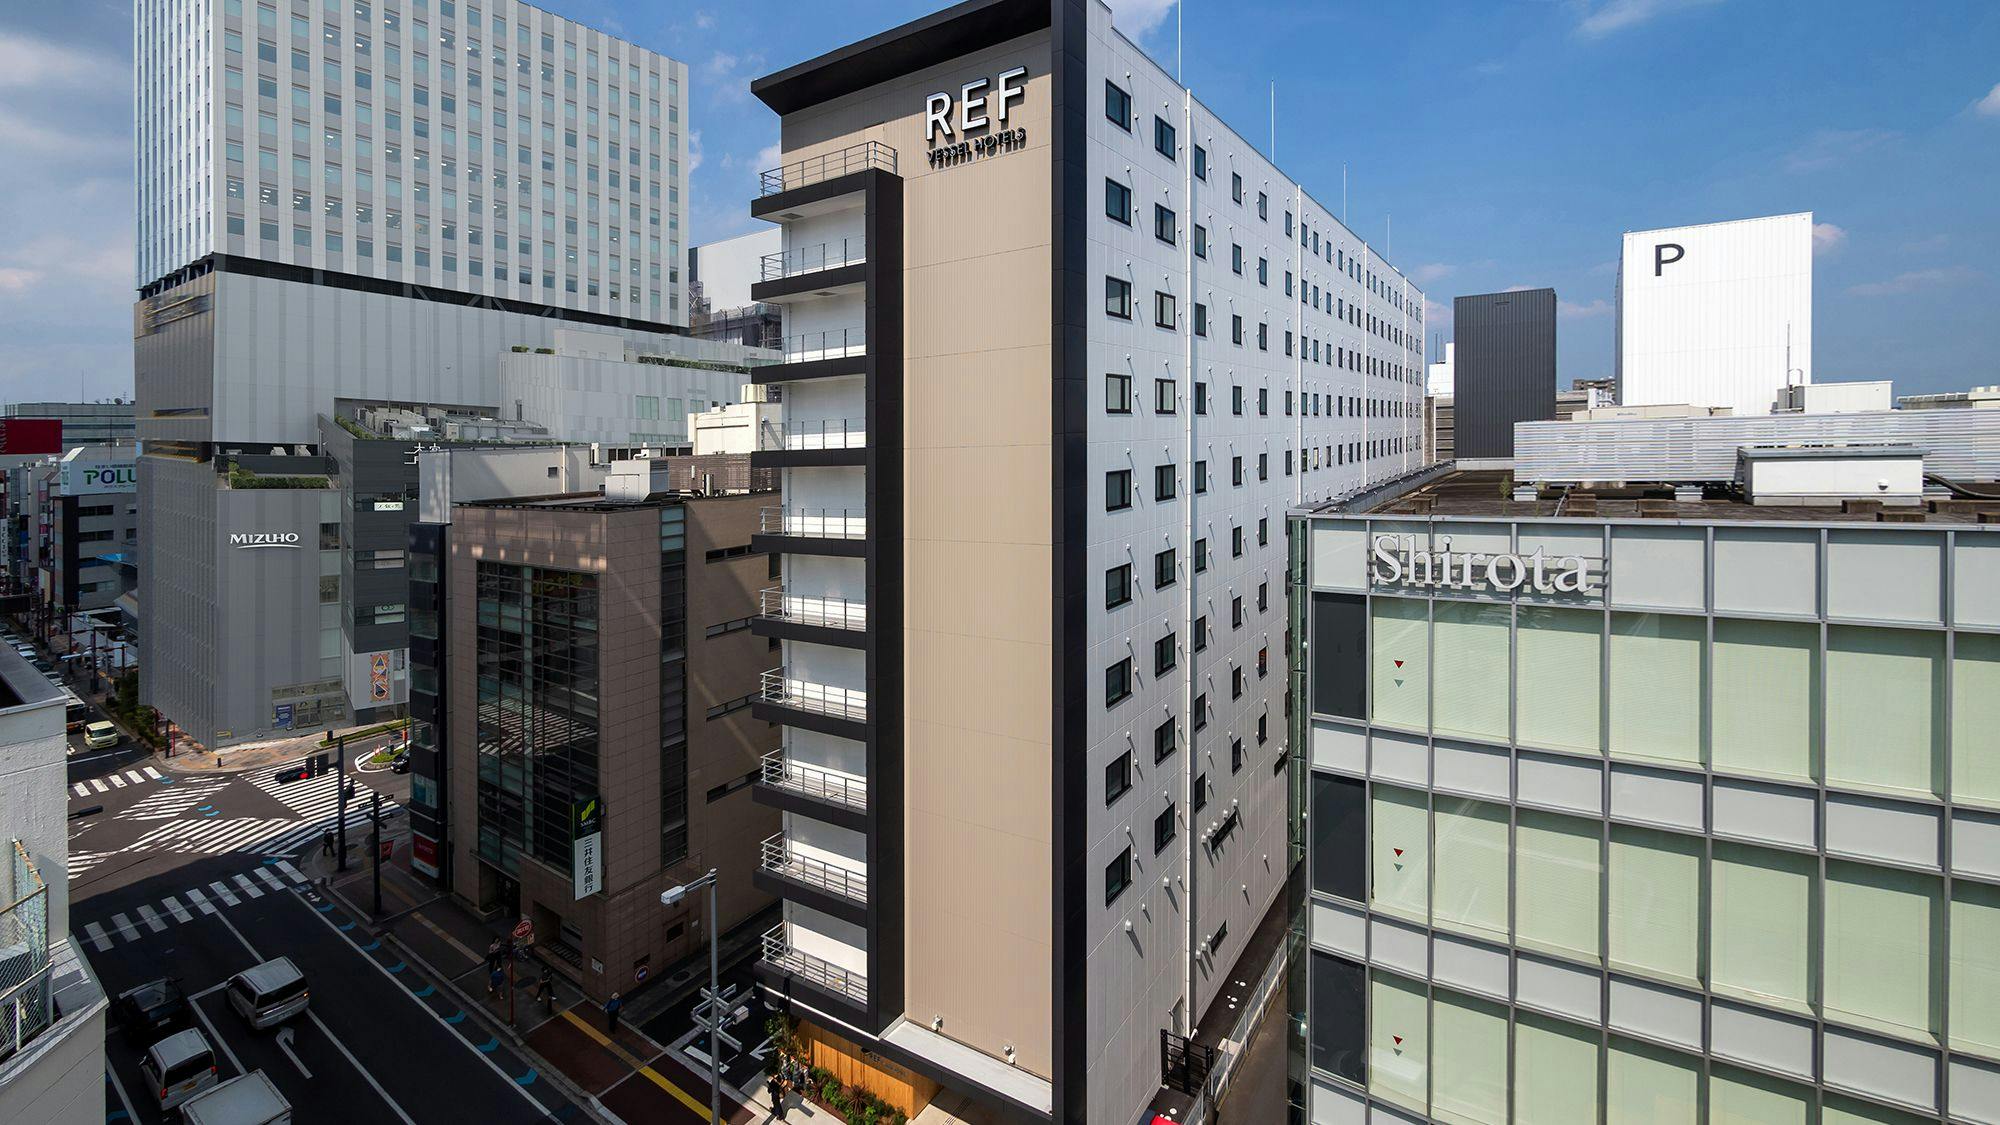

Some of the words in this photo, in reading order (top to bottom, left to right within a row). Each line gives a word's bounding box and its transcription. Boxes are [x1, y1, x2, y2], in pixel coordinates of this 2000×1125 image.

[926, 66, 1027, 141] REF
[926, 141, 971, 163] VESSEL
[974, 127, 1026, 154] HOTELS
[1655, 243, 1685, 277] P
[229, 532, 299, 544] MIZUHO
[1373, 534, 1595, 593] Shirota
[584, 838, 593, 894] 三井住友銀行
